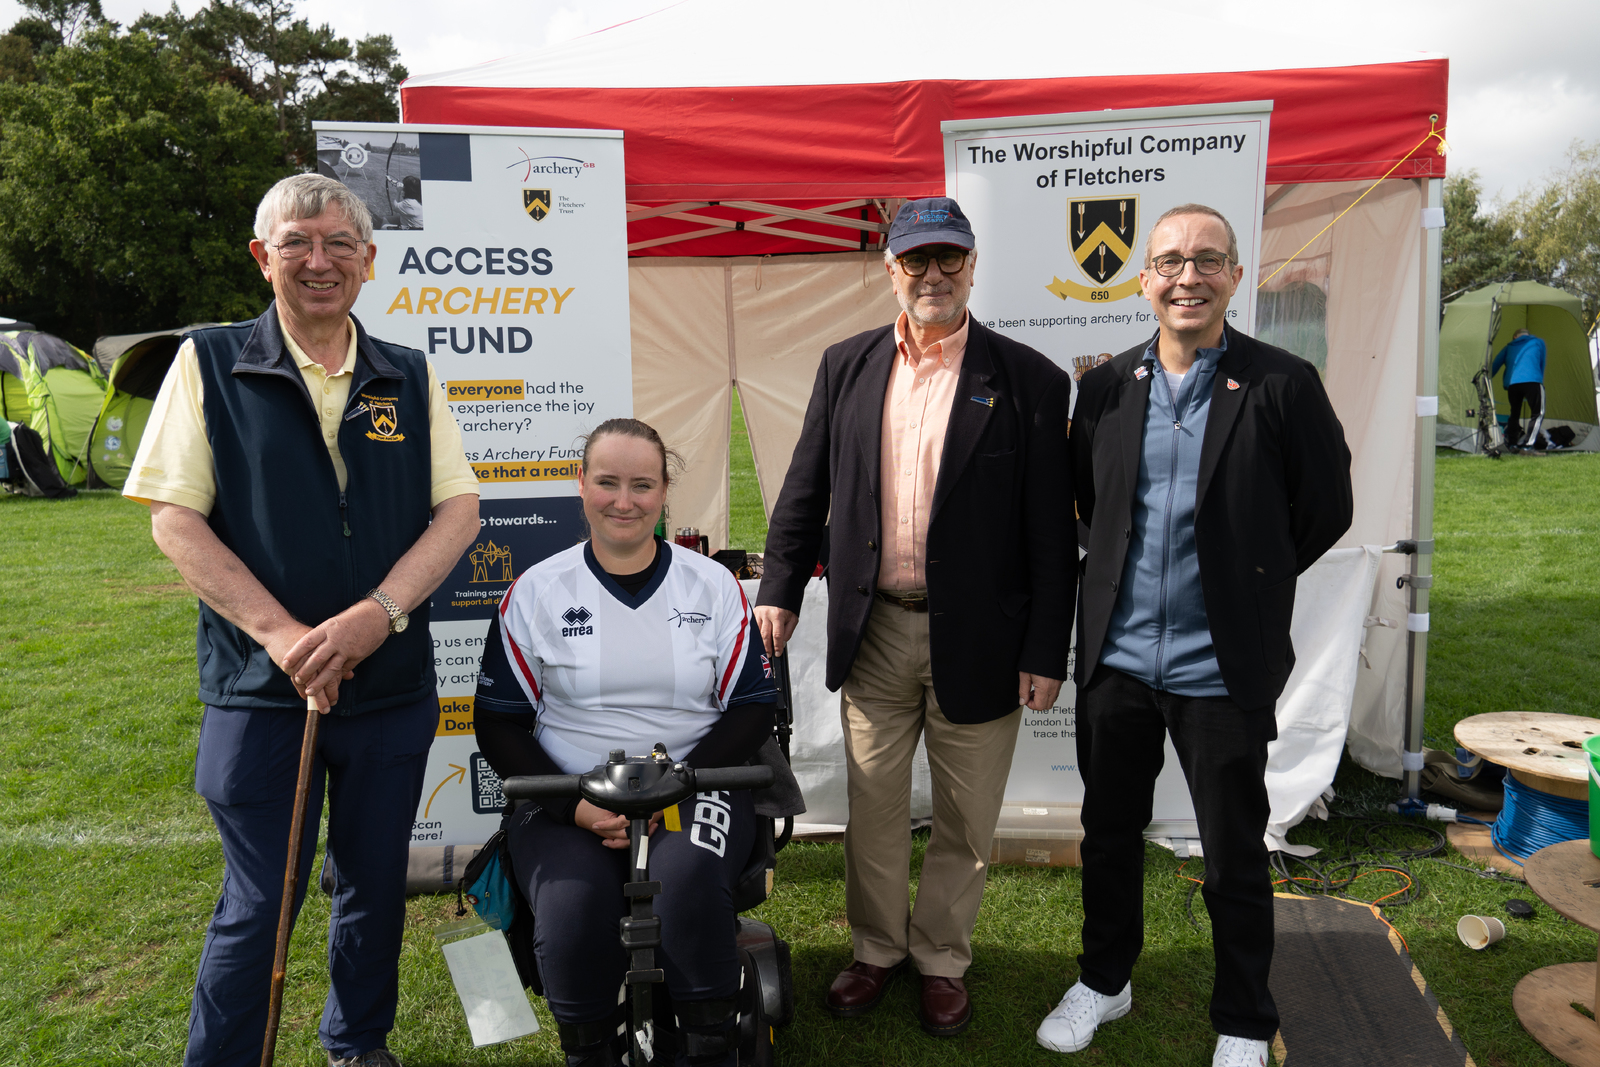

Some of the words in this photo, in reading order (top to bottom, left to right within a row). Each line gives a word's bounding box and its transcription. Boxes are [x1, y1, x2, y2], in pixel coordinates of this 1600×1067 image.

[968, 146, 1006, 164] The
[1013, 136, 1132, 162] Worshipful
[1140, 134, 1246, 154] Company
[533, 160, 583, 178] archery
[1036, 170, 1058, 188] of
[1064, 164, 1166, 187] Fletchers
[398, 246, 553, 276] ACCESS
[386, 287, 576, 314] ARCHERY
[1090, 290, 1110, 301] 650
[998, 318, 1026, 328] been
[1029, 315, 1086, 328] supporting
[1090, 313, 1132, 325] archery
[1136, 312, 1150, 322] for
[428, 326, 533, 354] FUND
[448, 384, 522, 398] everyone
[526, 381, 556, 394] had
[560, 381, 584, 394] the
[458, 400, 542, 417] experience
[545, 400, 570, 412] the
[574, 400, 595, 414] joy
[463, 418, 532, 434] archery?
[482, 446, 546, 462] Archery
[472, 466, 490, 479] ke
[492, 466, 527, 478] that
[530, 468, 540, 477] a
[544, 463, 578, 476] reali
[489, 514, 558, 526] towards...
[455, 590, 487, 598] Training
[451, 599, 482, 608] support
[562, 625, 593, 637] errea
[445, 638, 461, 648] us
[446, 656, 474, 666] can
[451, 671, 479, 684] acti
[440, 701, 470, 713] ake
[1052, 706, 1076, 714] Fletc
[445, 719, 475, 731] Don
[1024, 718, 1062, 726] London
[1064, 718, 1077, 726] Liv
[412, 820, 442, 830] Scan
[410, 830, 443, 841] here!
